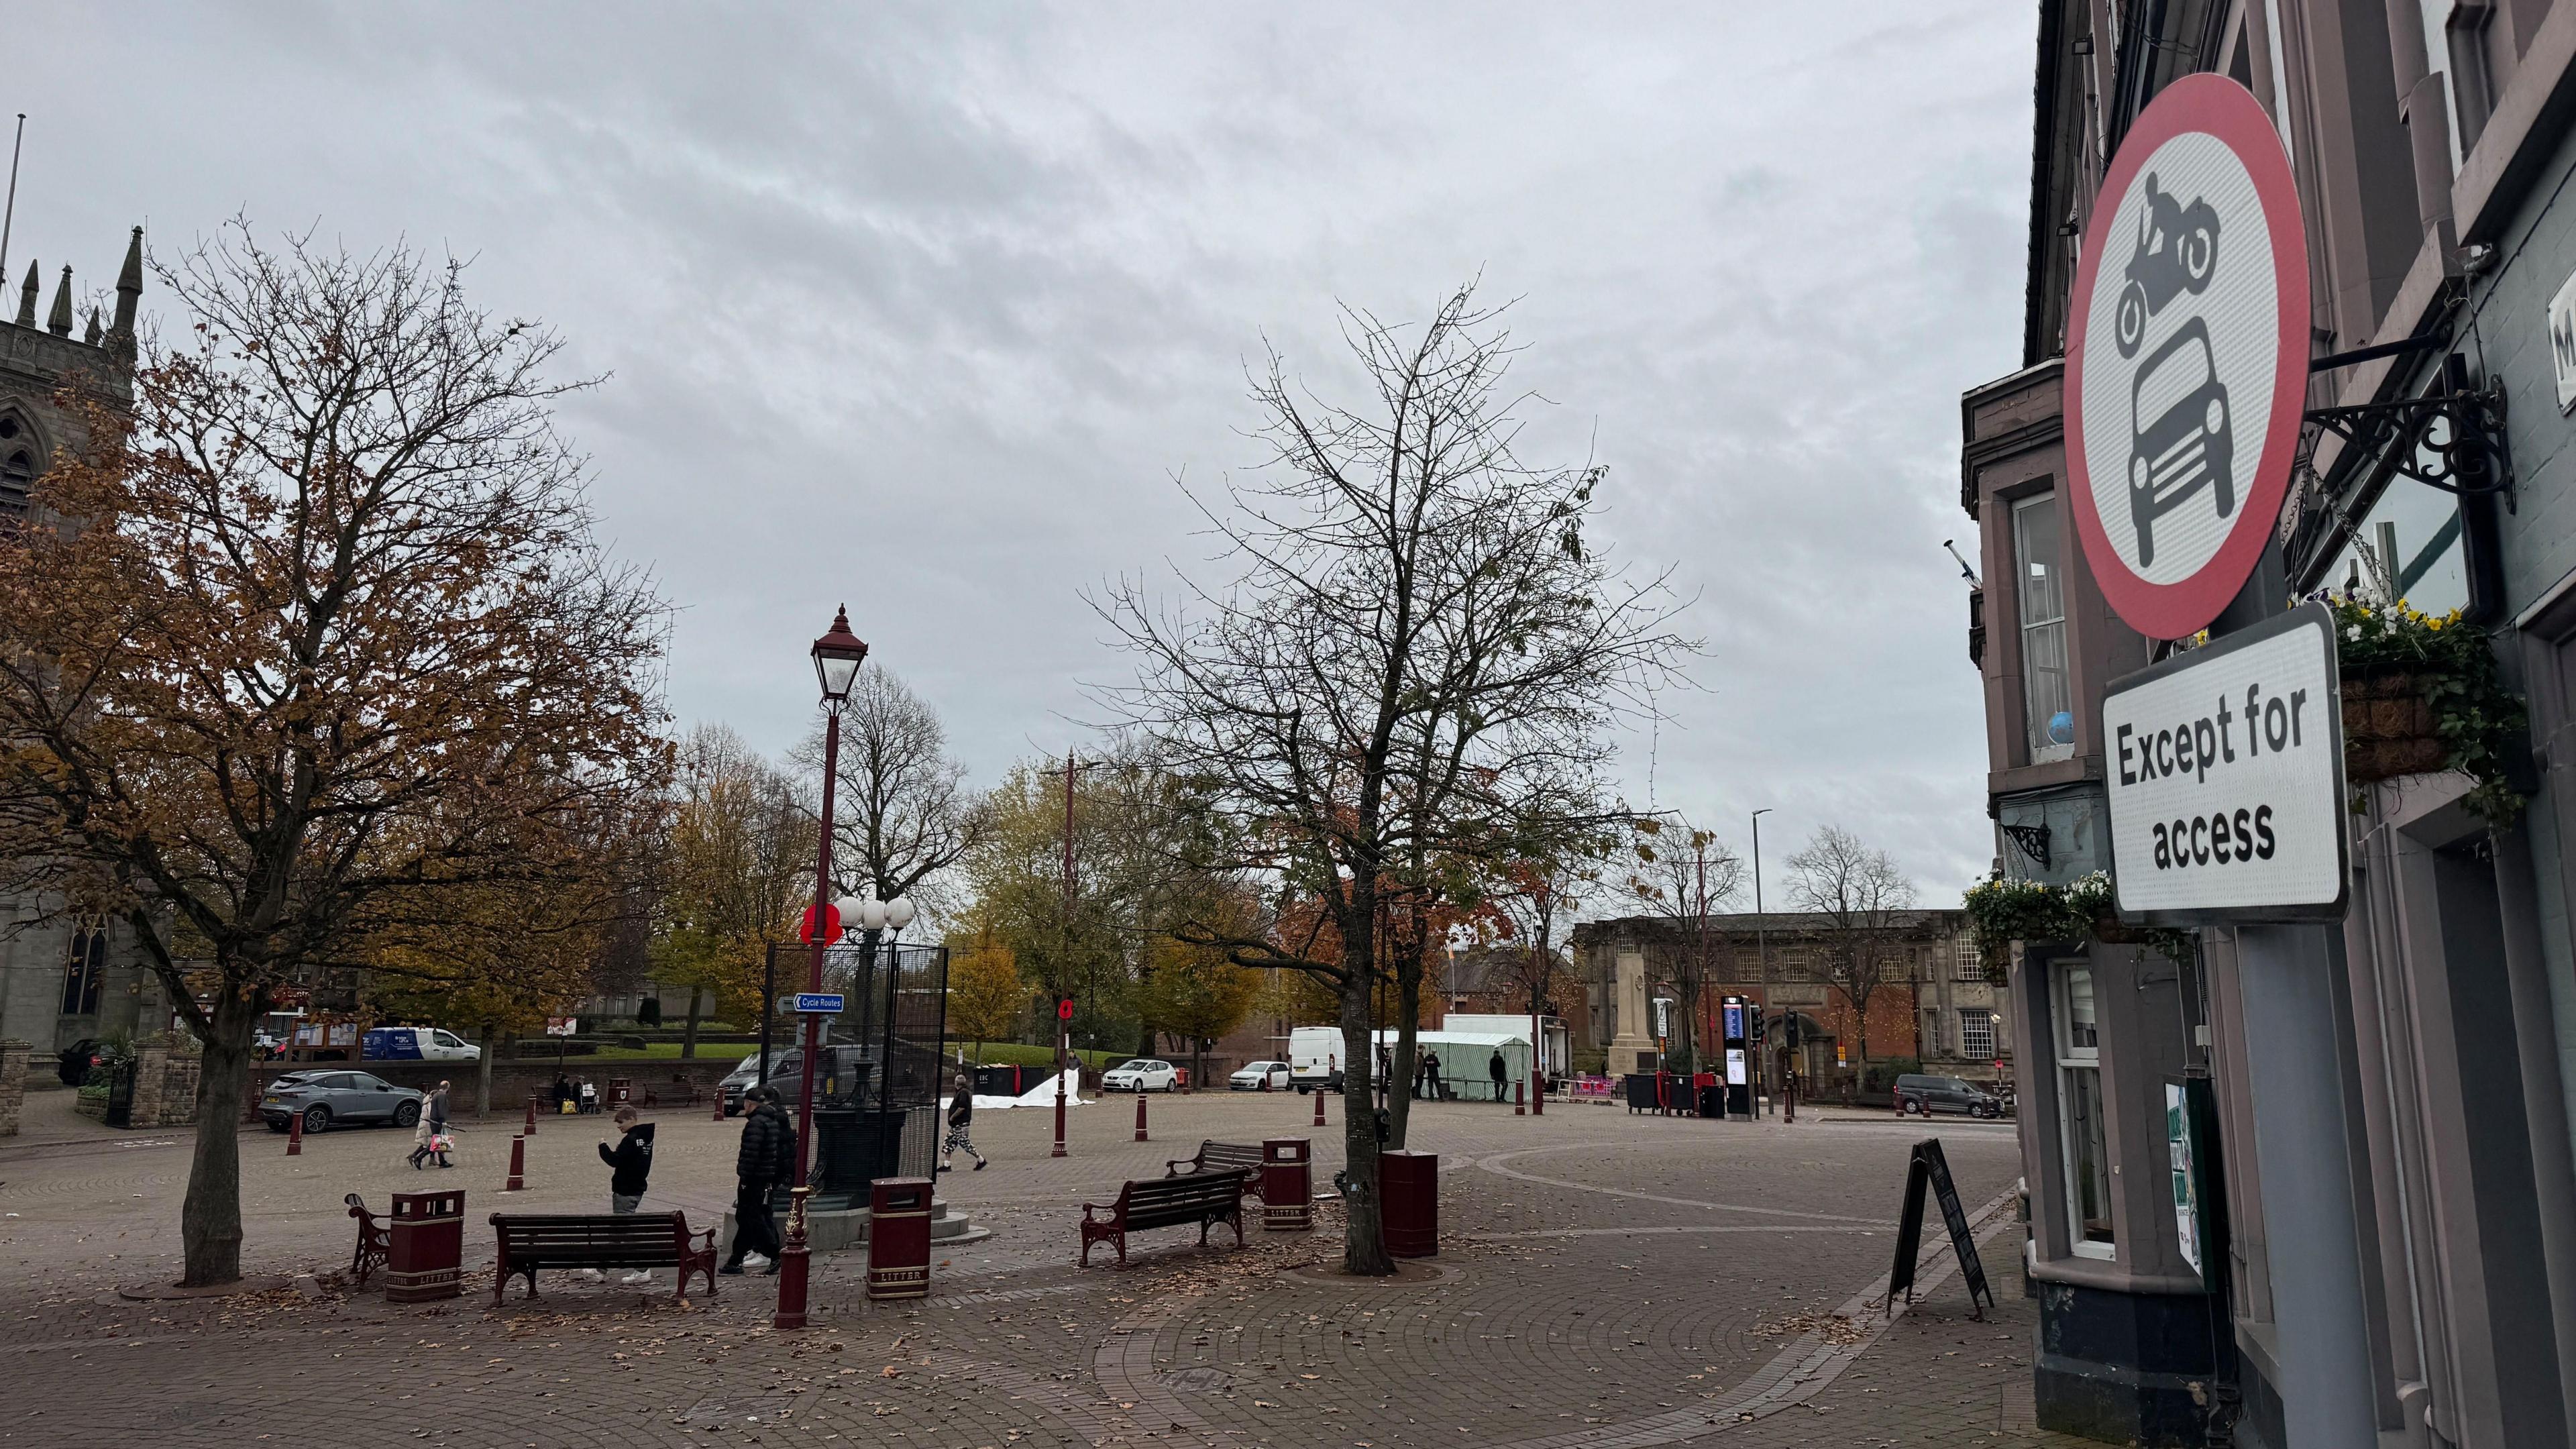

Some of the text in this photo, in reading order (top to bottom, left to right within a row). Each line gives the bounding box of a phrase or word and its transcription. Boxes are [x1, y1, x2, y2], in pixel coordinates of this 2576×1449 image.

[2117, 683, 2306, 786] Except for
[2153, 805, 2275, 869] access
[802, 998, 841, 1007] Cycle Routes
[420, 1273, 454, 1284] LITTER
[881, 1271, 921, 1281] LITTER
